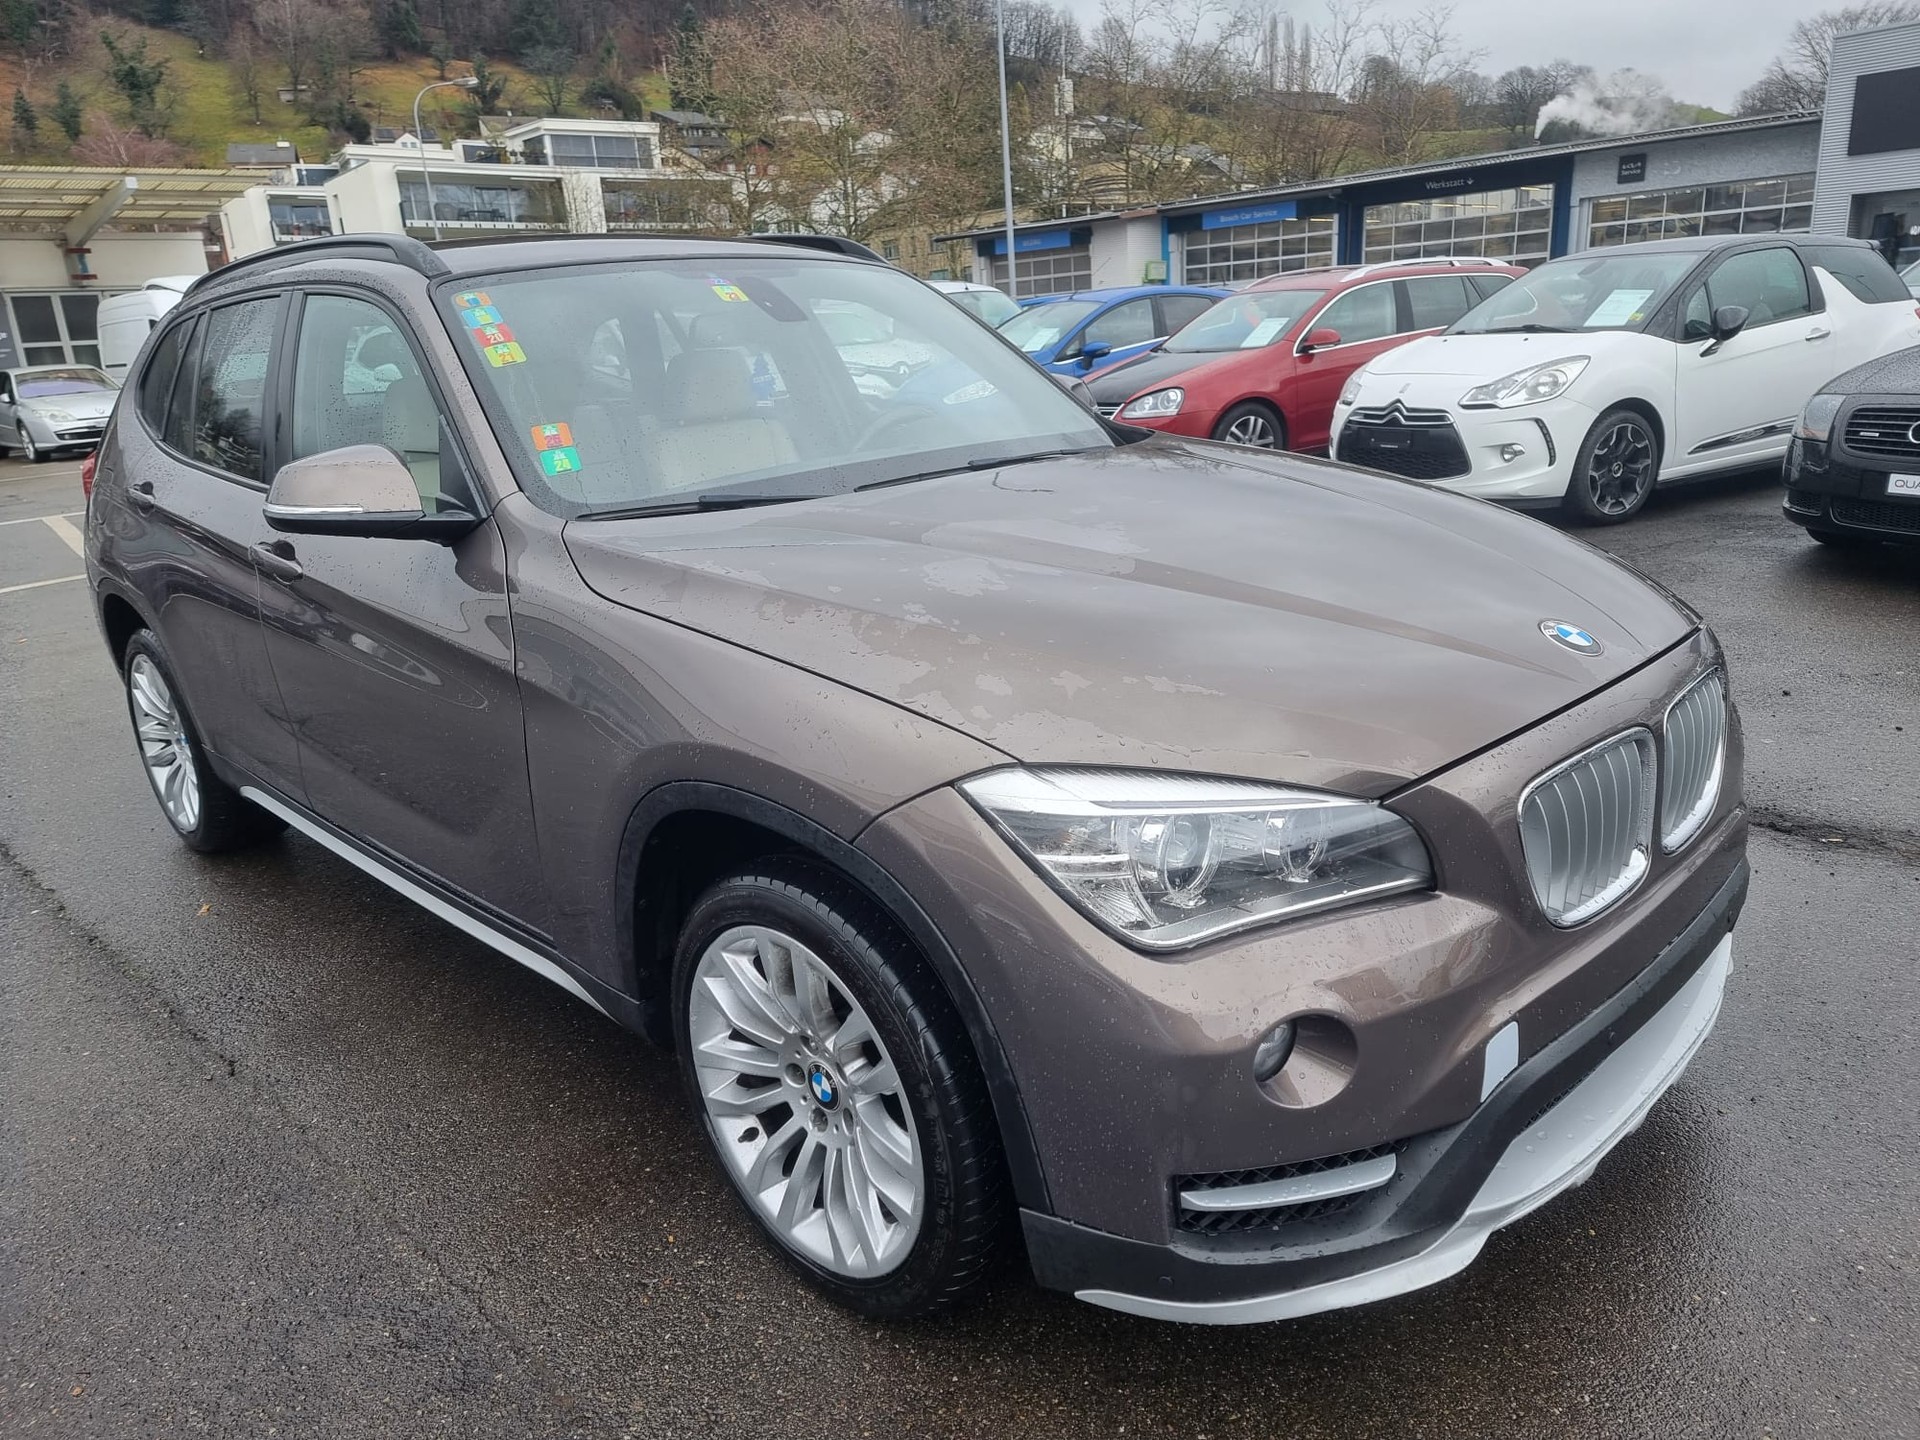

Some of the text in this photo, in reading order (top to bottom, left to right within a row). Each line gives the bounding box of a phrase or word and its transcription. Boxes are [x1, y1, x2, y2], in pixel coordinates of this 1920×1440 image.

[1425, 179, 1464, 190] Werkstatt
[1240, 212, 1252, 220] Car
[1253, 210, 1278, 219] Service
[486, 332, 505, 344] 20
[811, 1066, 837, 1089] BMW
